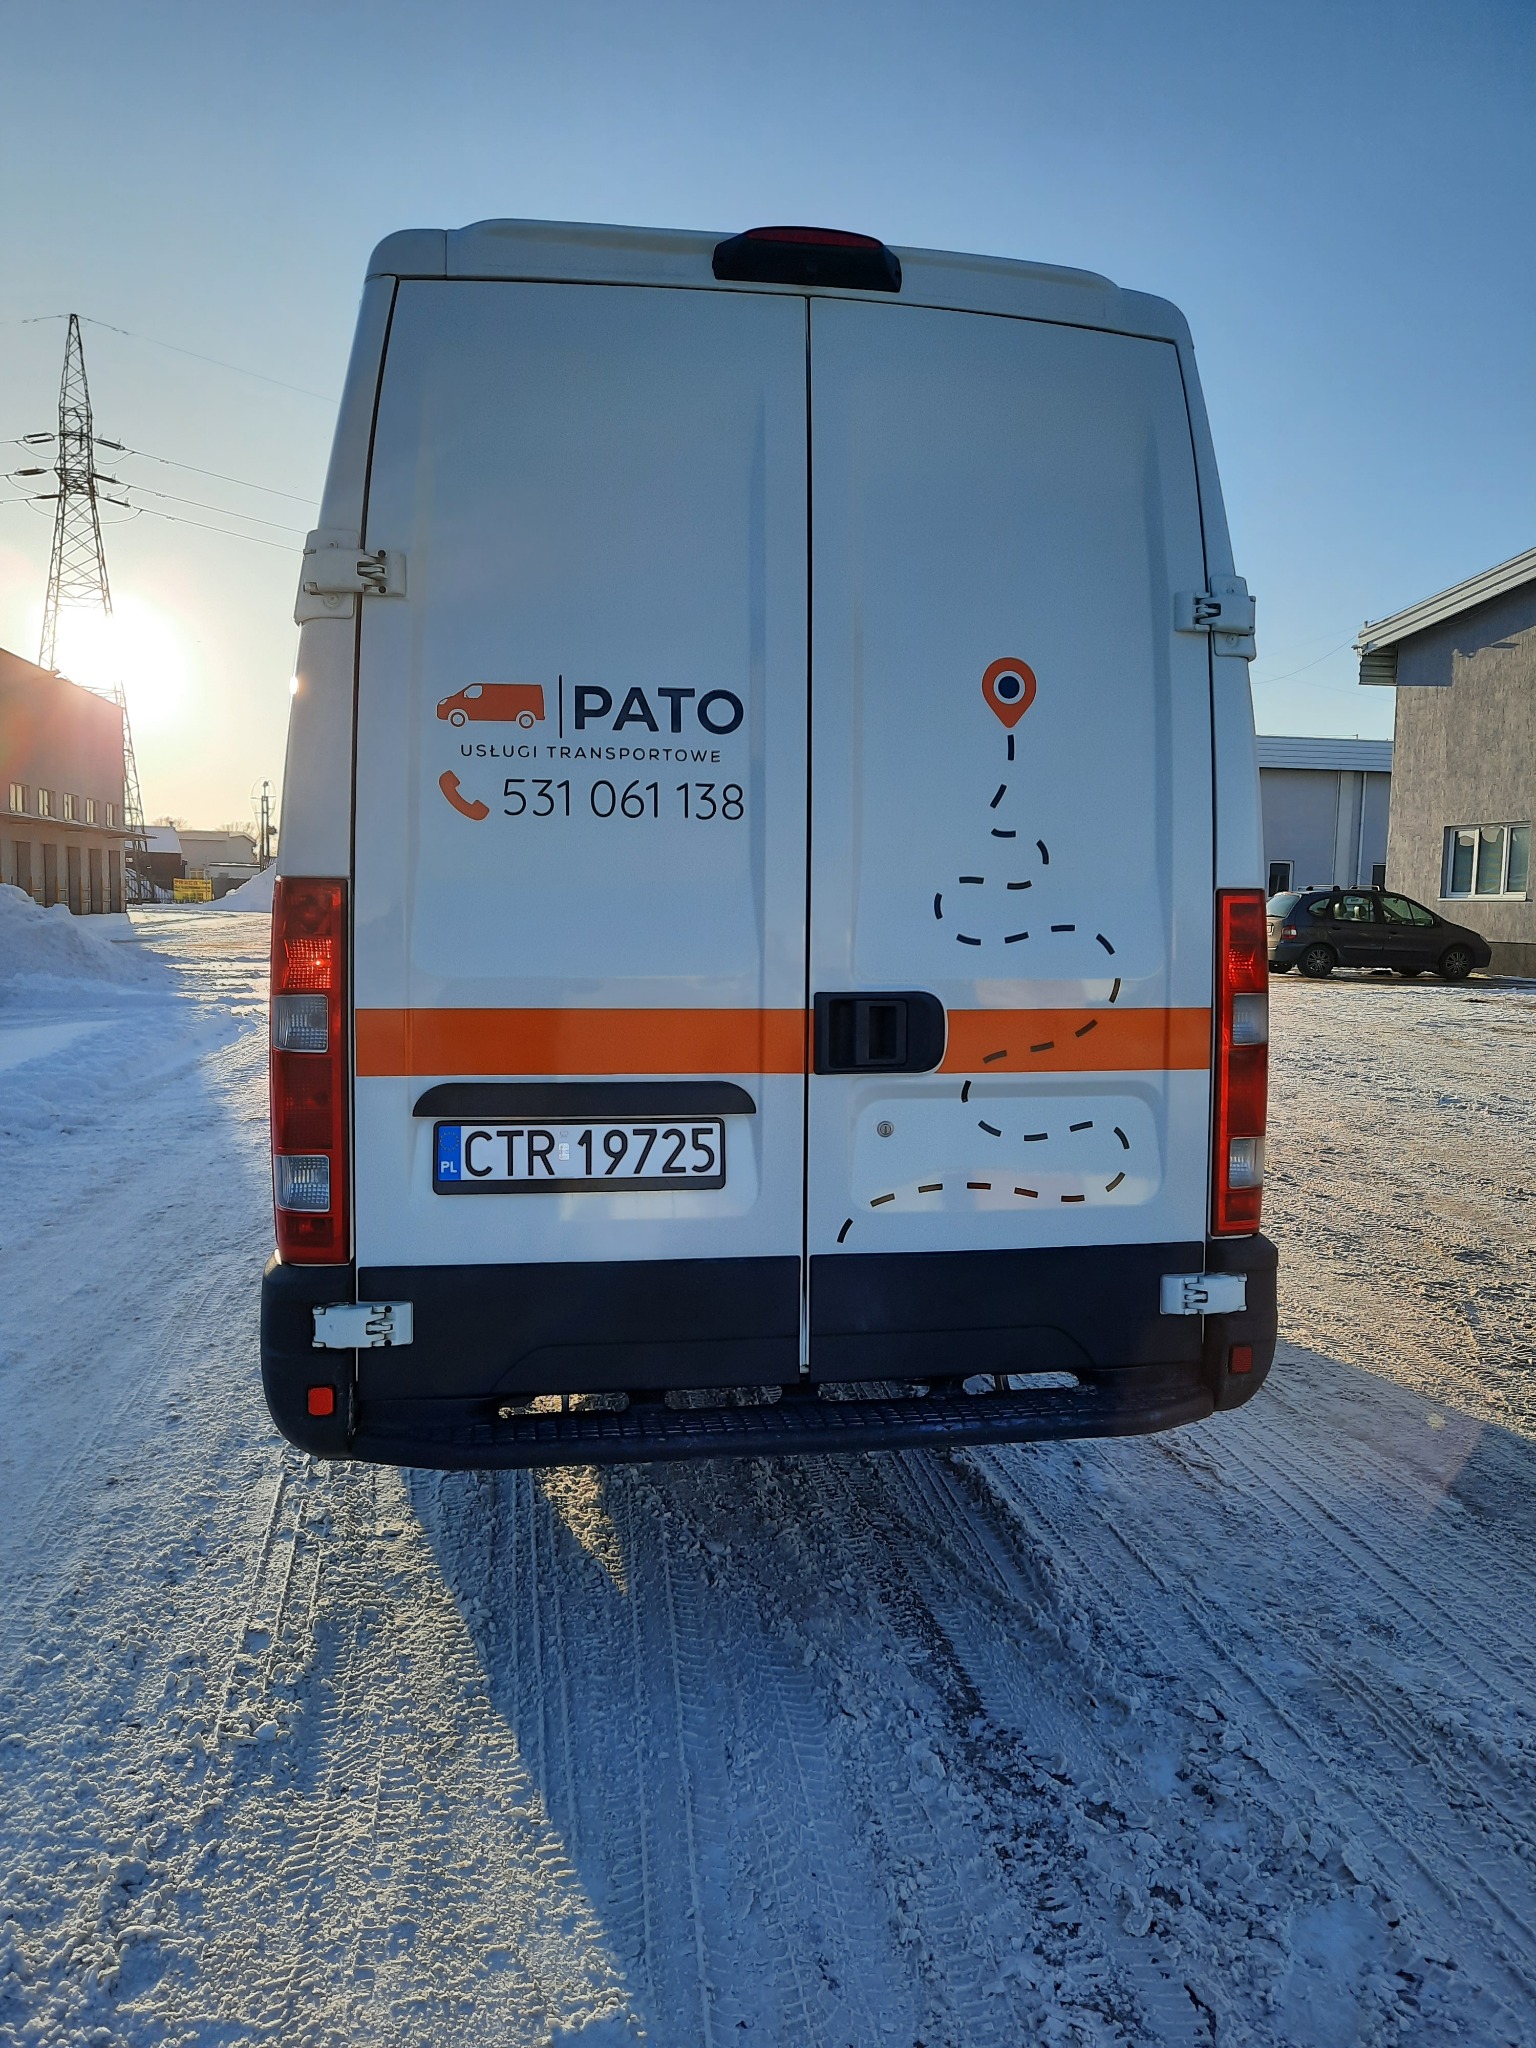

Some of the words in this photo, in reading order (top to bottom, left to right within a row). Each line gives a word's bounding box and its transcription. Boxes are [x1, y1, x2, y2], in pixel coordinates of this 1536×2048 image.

[574, 685, 744, 735] PATO
[460, 744, 537, 759] USŁUGI
[546, 745, 721, 763] TRANSPORTOWE
[503, 778, 570, 816] 531
[590, 779, 659, 819] 061
[675, 782, 745, 821] 138
[440, 1161, 457, 1173] PL
[464, 1130, 556, 1177] CTR
[577, 1128, 715, 1176] 19725
